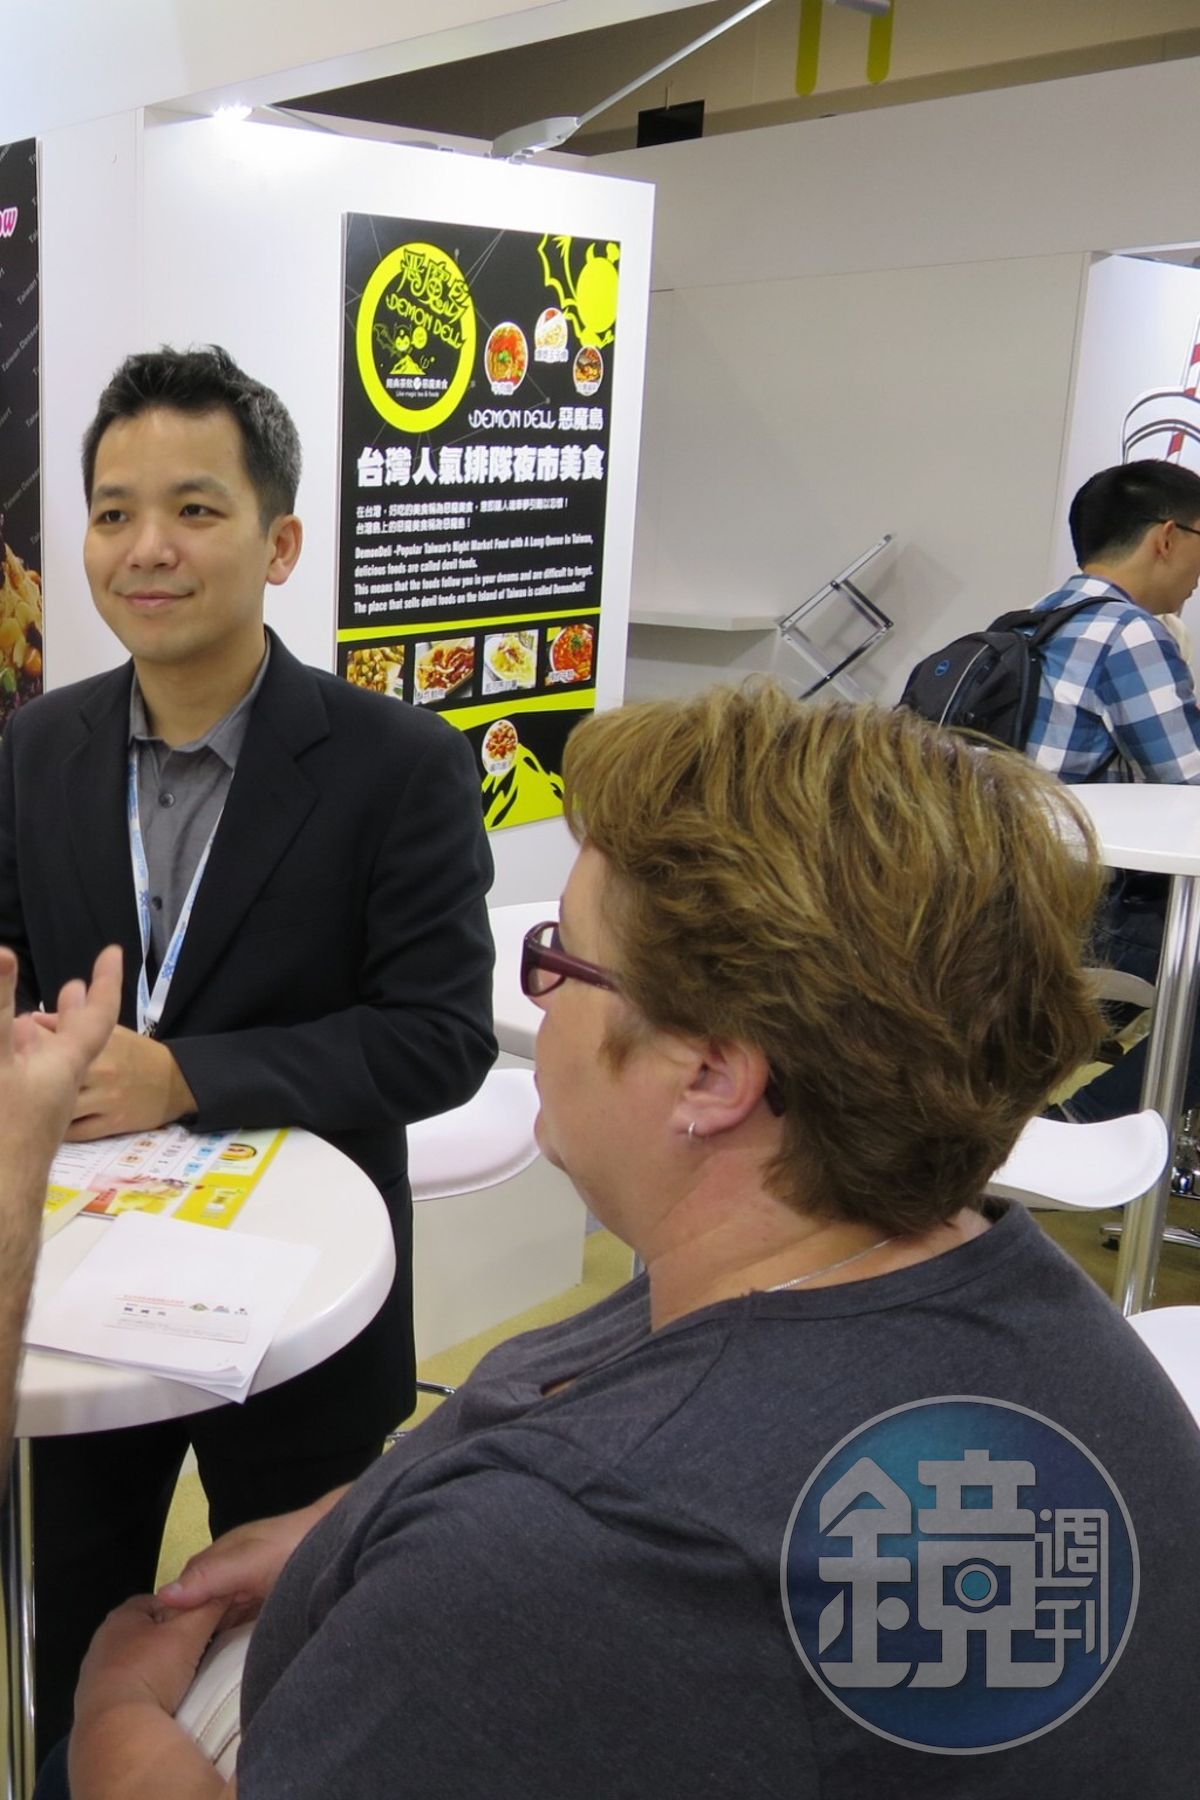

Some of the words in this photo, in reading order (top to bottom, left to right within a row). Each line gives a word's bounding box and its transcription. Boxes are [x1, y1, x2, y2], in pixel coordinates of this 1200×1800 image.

[468, 409, 521, 430] DEMON
[523, 409, 556, 430] DELL
[357, 444, 605, 488] 台灣人氣排隊夜市美食
